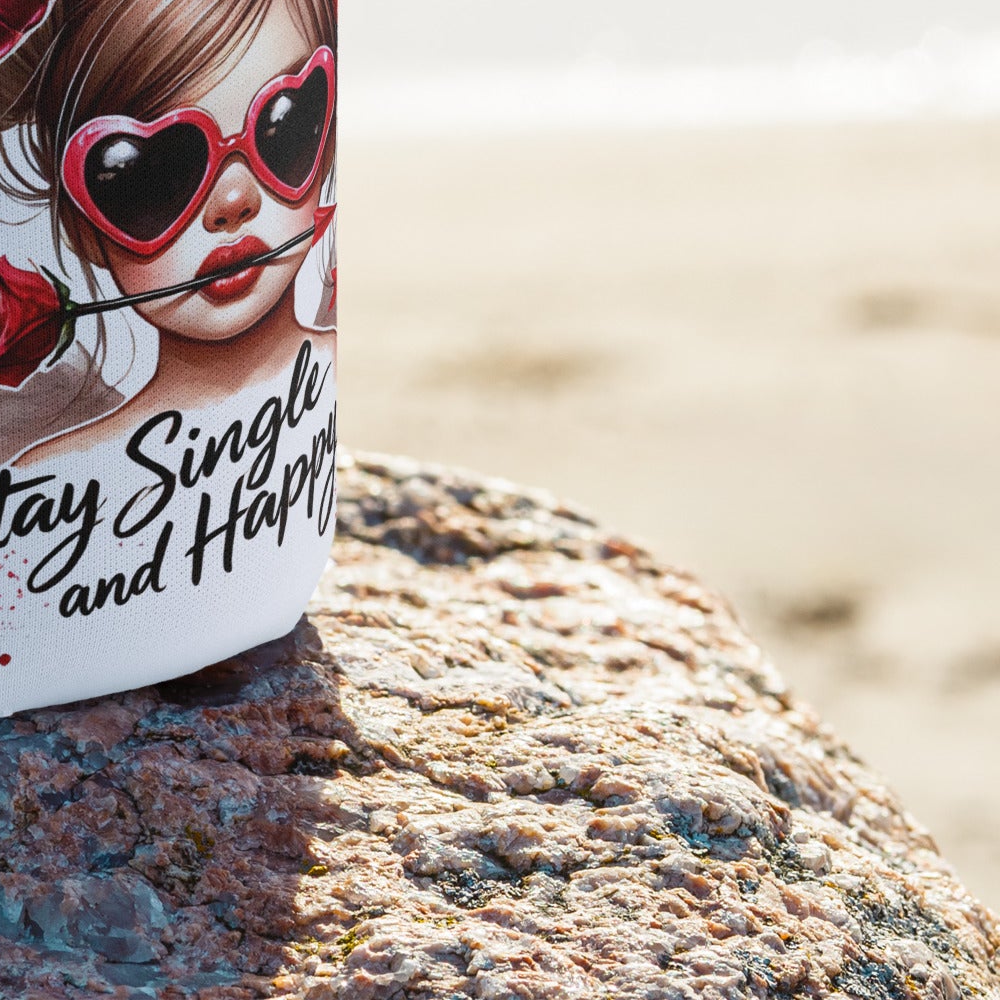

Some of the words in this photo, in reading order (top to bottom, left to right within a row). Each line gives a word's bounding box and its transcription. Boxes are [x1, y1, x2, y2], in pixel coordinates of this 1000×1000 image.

[58, 521, 173, 618] and
[185, 401, 337, 585] Happy
[113, 339, 330, 538] Single
